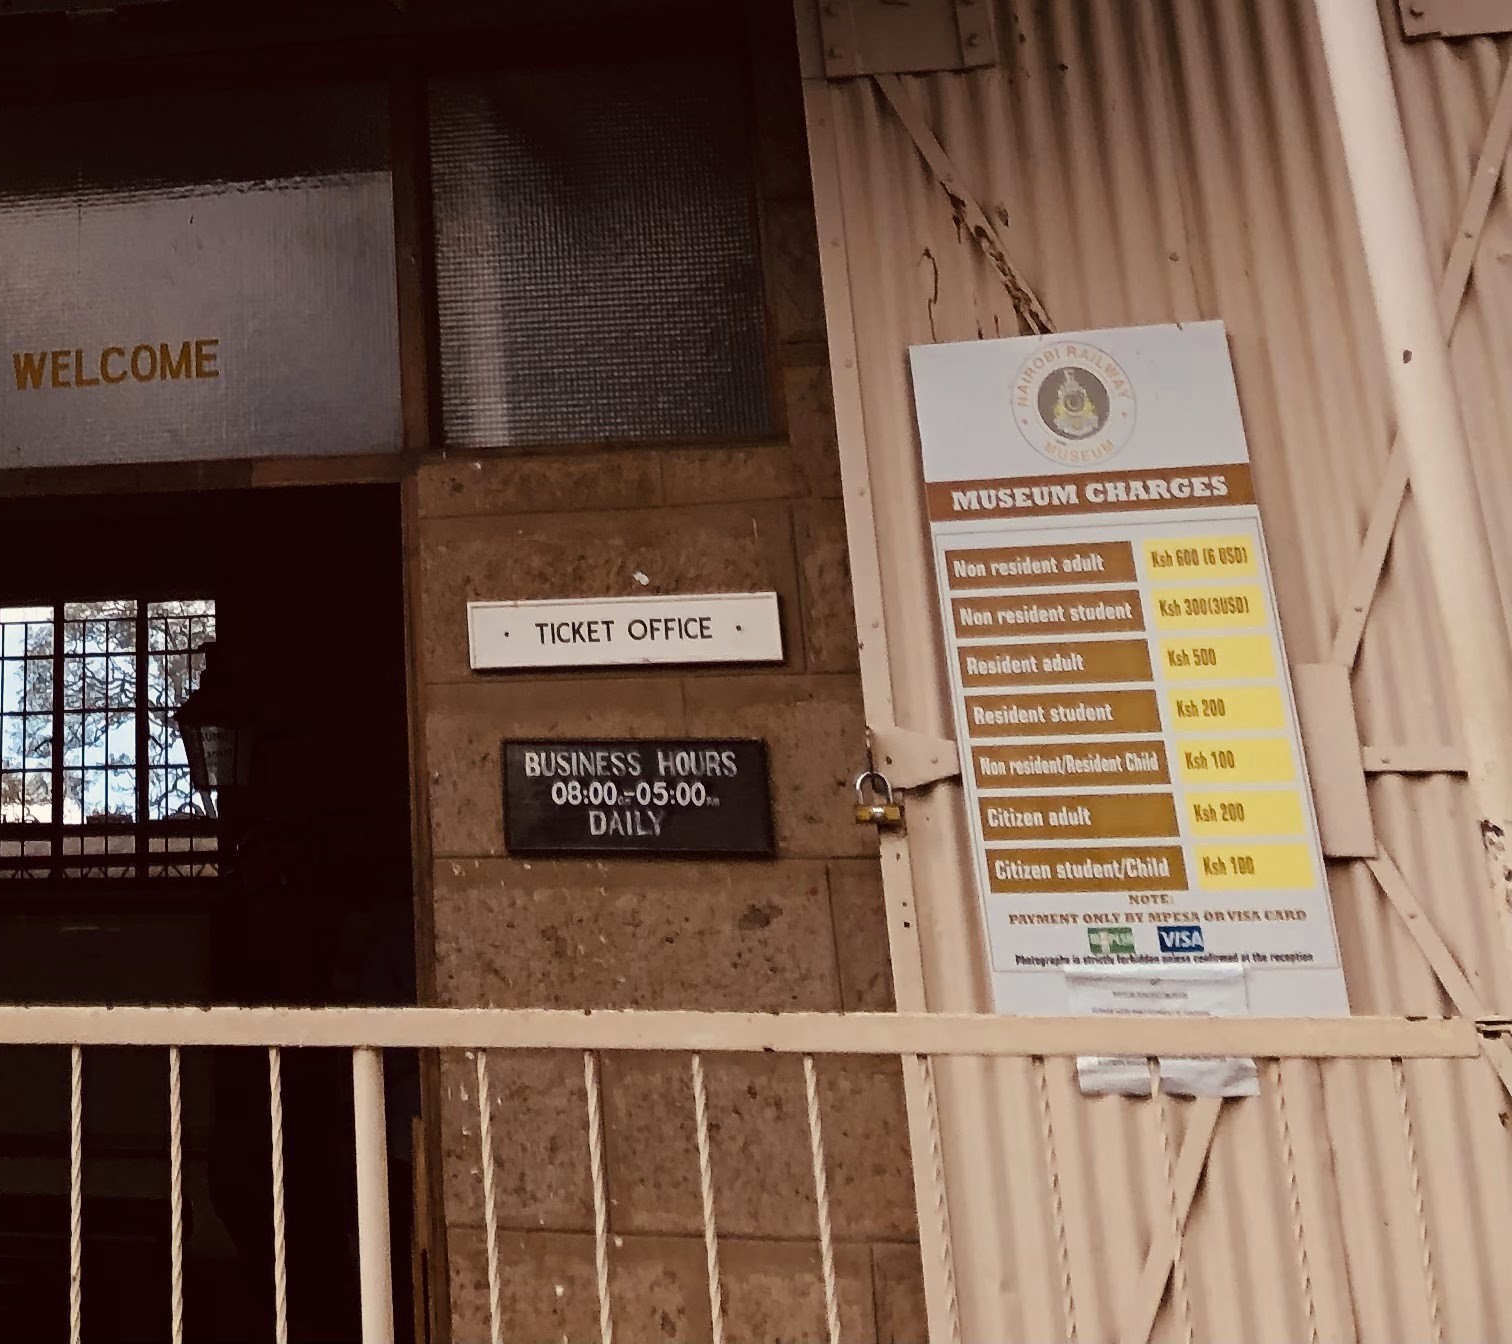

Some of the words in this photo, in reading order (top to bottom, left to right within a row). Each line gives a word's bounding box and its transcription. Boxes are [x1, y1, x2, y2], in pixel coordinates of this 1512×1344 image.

[12, 338, 220, 390] WELCOME
[1017, 349, 1061, 407] NAIROBI
[1067, 345, 1133, 399] RAILWAY
[1044, 439, 1116, 462] MUSEUM
[951, 483, 1080, 511] MUSEUM
[1085, 475, 1230, 503] CHARGES
[953, 559, 986, 578] Non
[991, 557, 1059, 577] resident
[1063, 553, 1105, 572] adult
[1151, 550, 1173, 568] Ksh
[960, 606, 993, 626] Non
[997, 604, 1065, 624] resident
[1069, 602, 1133, 622] student
[1159, 598, 1182, 617] Ksh
[534, 619, 615, 645] TICKET
[627, 616, 713, 641] OFFICE
[966, 655, 1038, 675] Resident
[1043, 652, 1084, 673] adult
[1167, 648, 1190, 667] Ksh
[1193, 647, 1217, 666] 500
[973, 705, 1045, 725] Resident
[1050, 703, 1114, 723] student
[1176, 699, 1199, 718] Ksh
[1201, 698, 1226, 717] 200
[524, 751, 642, 777] BUSINESS
[657, 750, 738, 777] HOURS
[979, 756, 1005, 775] Non
[1008, 753, 1122, 776] resident/Resident
[1125, 751, 1159, 773] Child
[1184, 751, 1208, 770] Ksh
[1211, 749, 1236, 769] 100
[589, 810, 664, 837] DAILY
[987, 808, 1044, 829] Citizen
[1049, 806, 1092, 827] adult
[1193, 803, 1217, 823] Ksh
[1220, 802, 1245, 822] 200
[995, 860, 1052, 881] Citizen
[1056, 857, 1171, 879] student/Child
[1203, 857, 1227, 876] Ksh
[1230, 856, 1255, 875] 100
[1128, 894, 1174, 905] NOTE:
[1008, 913, 1079, 925] PAYMENT
[1082, 912, 1121, 924] ONLY
[1124, 911, 1144, 923] BY
[1148, 911, 1201, 923] MPESA
[1203, 910, 1226, 922] OR
[1226, 910, 1262, 922] VISA
[1264, 909, 1308, 921] CARD
[1159, 930, 1205, 948] VISA
[1116, 953, 1160, 965] forbidden
[1252, 952, 1267, 963] the
[1270, 952, 1314, 965] reception
